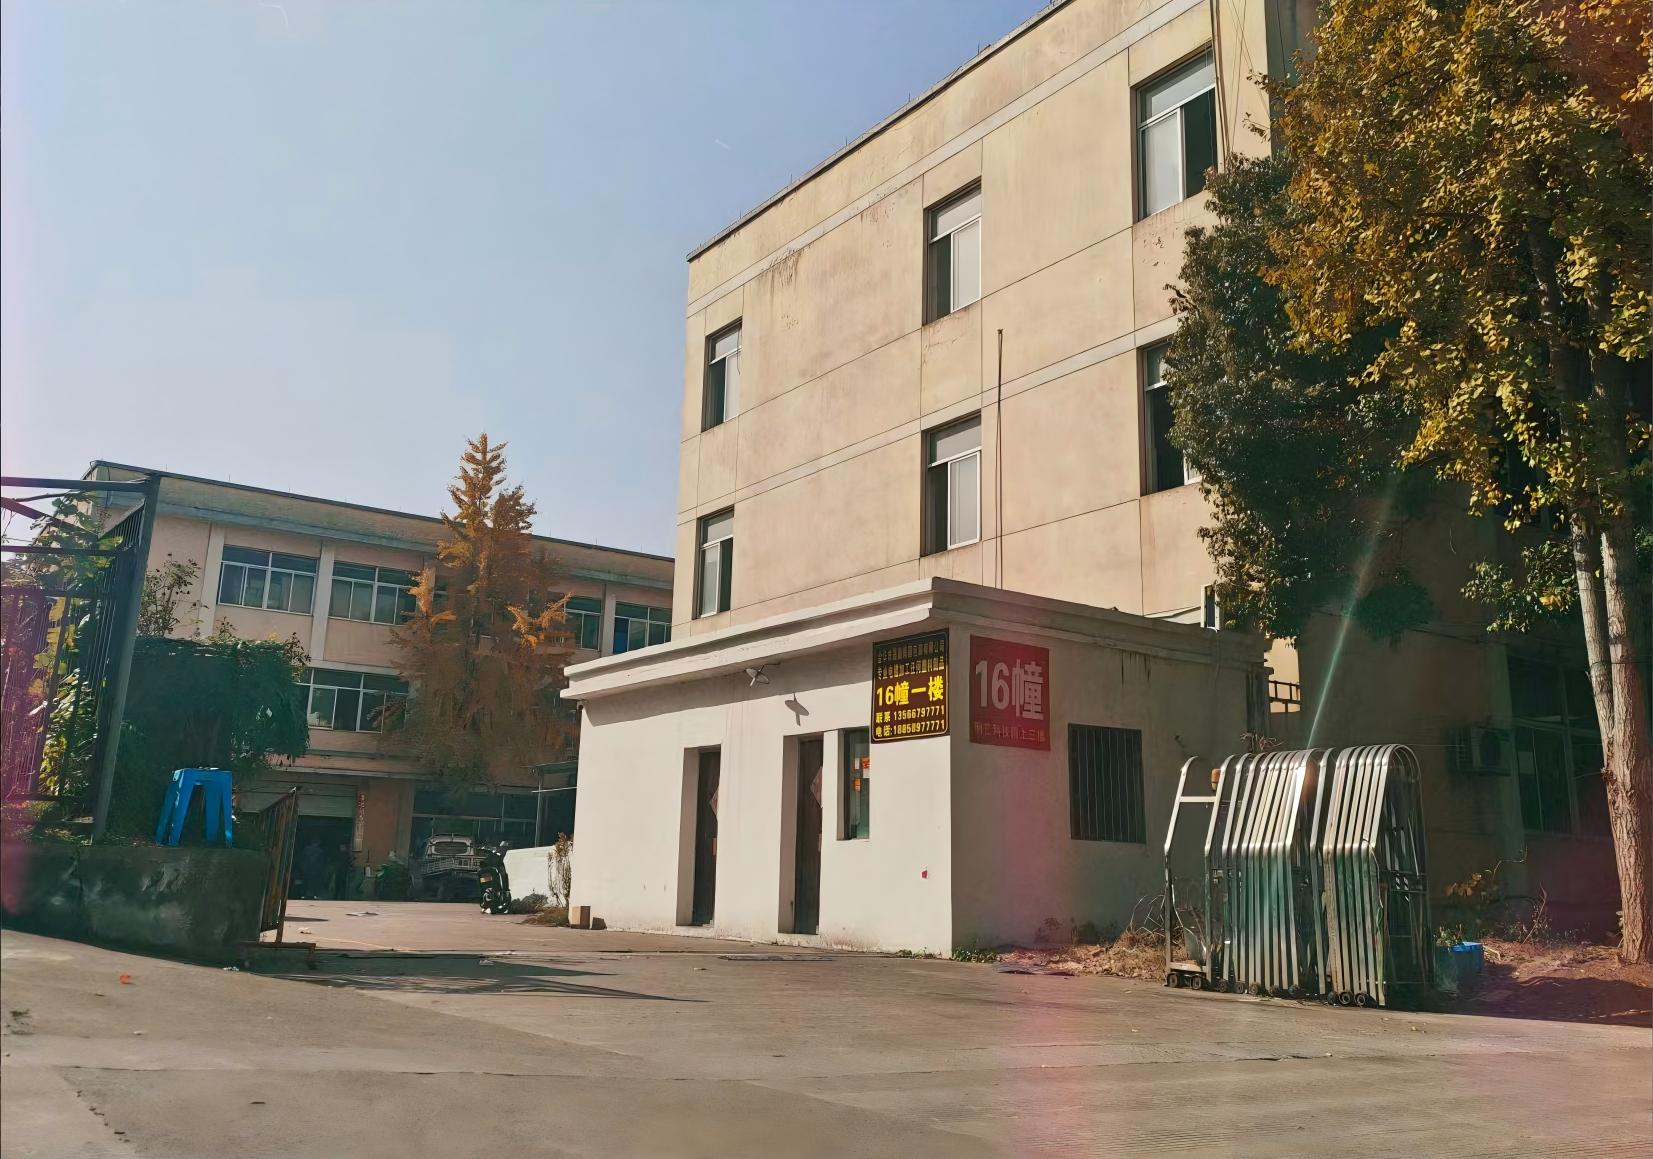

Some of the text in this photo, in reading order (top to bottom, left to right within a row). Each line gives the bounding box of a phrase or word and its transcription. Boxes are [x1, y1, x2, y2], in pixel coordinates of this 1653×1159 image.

[876, 676, 944, 706] 16幢一楼
[975, 659, 1044, 720] 16幢
[876, 705, 945, 723] 联系 13566797771
